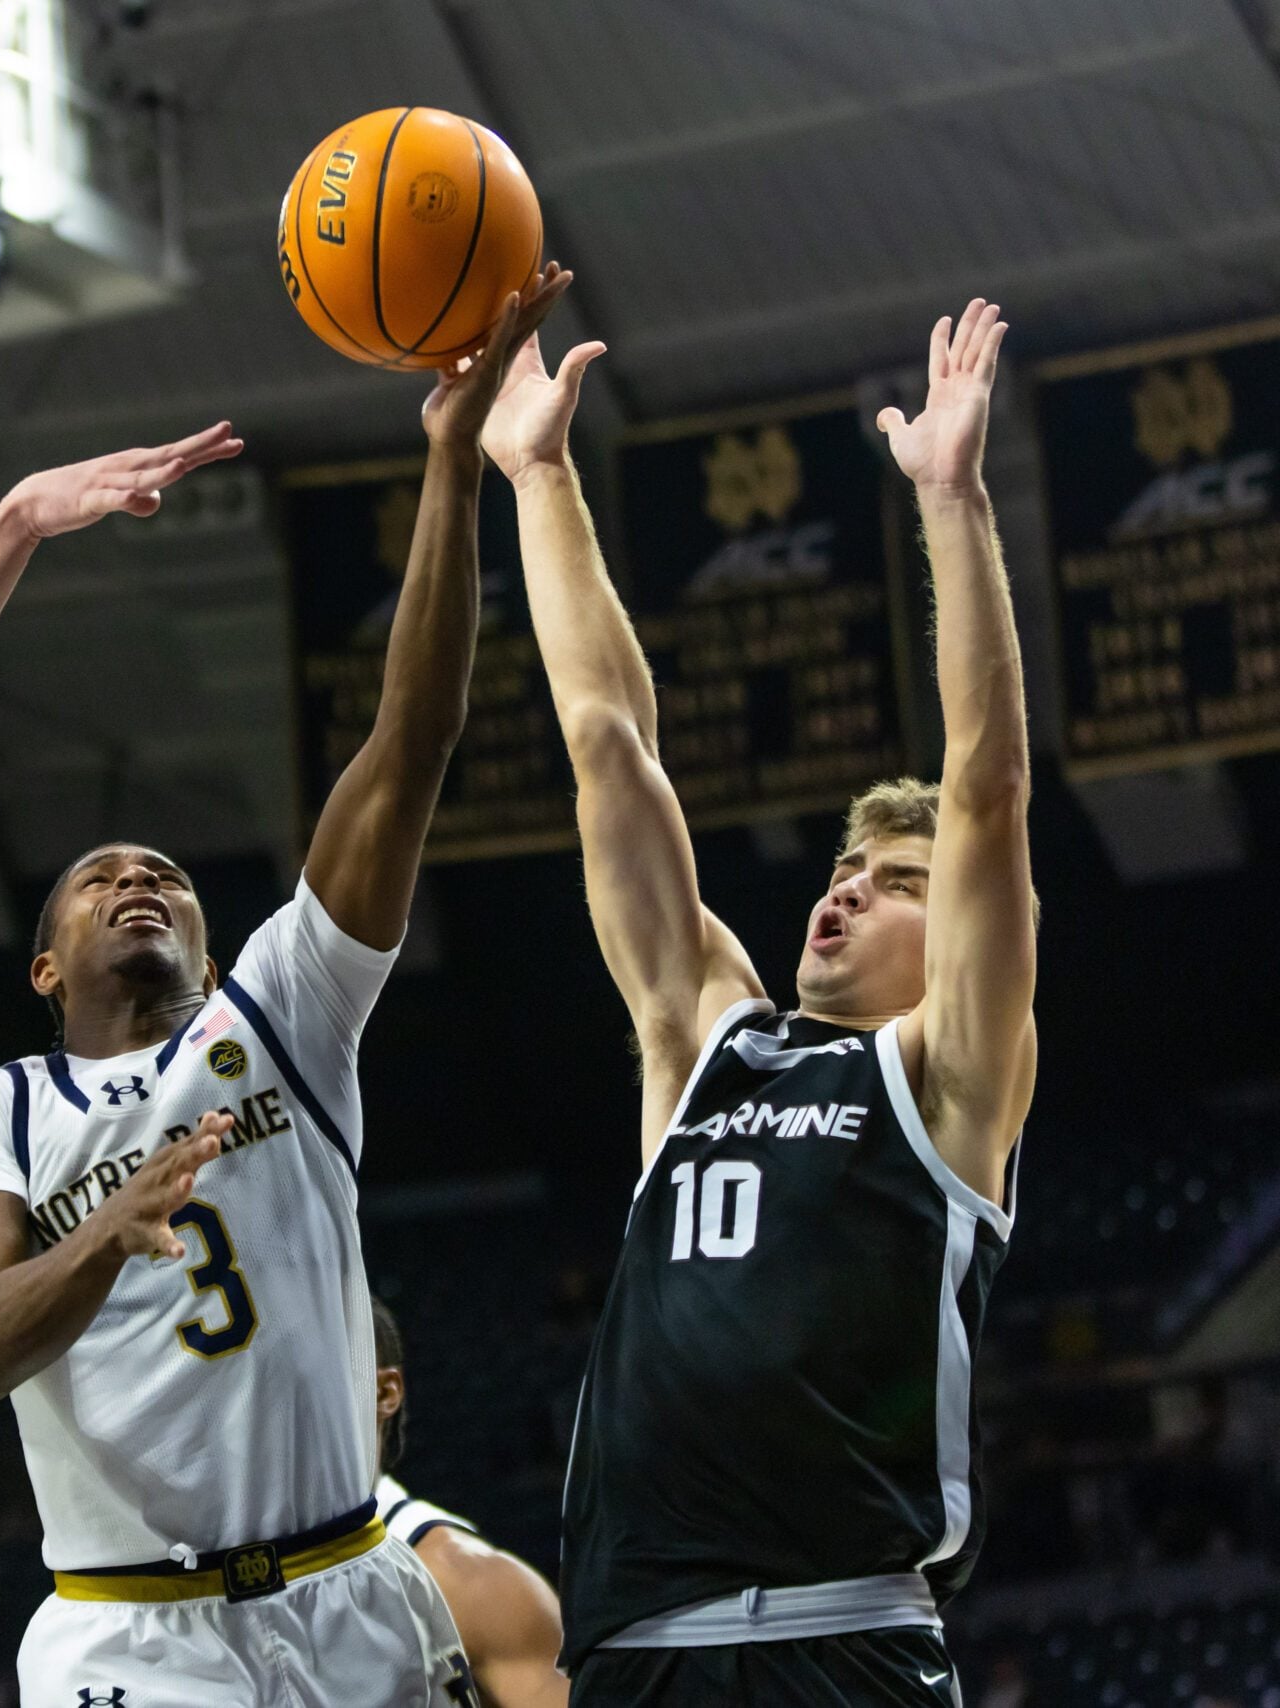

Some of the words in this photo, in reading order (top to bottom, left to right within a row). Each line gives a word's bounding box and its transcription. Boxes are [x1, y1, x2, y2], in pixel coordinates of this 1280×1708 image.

[214, 1046, 244, 1068] ACC
[27, 1147, 146, 1250] NOTRE
[671, 1160, 762, 1263] 10
[150, 1197, 260, 1361] 3
